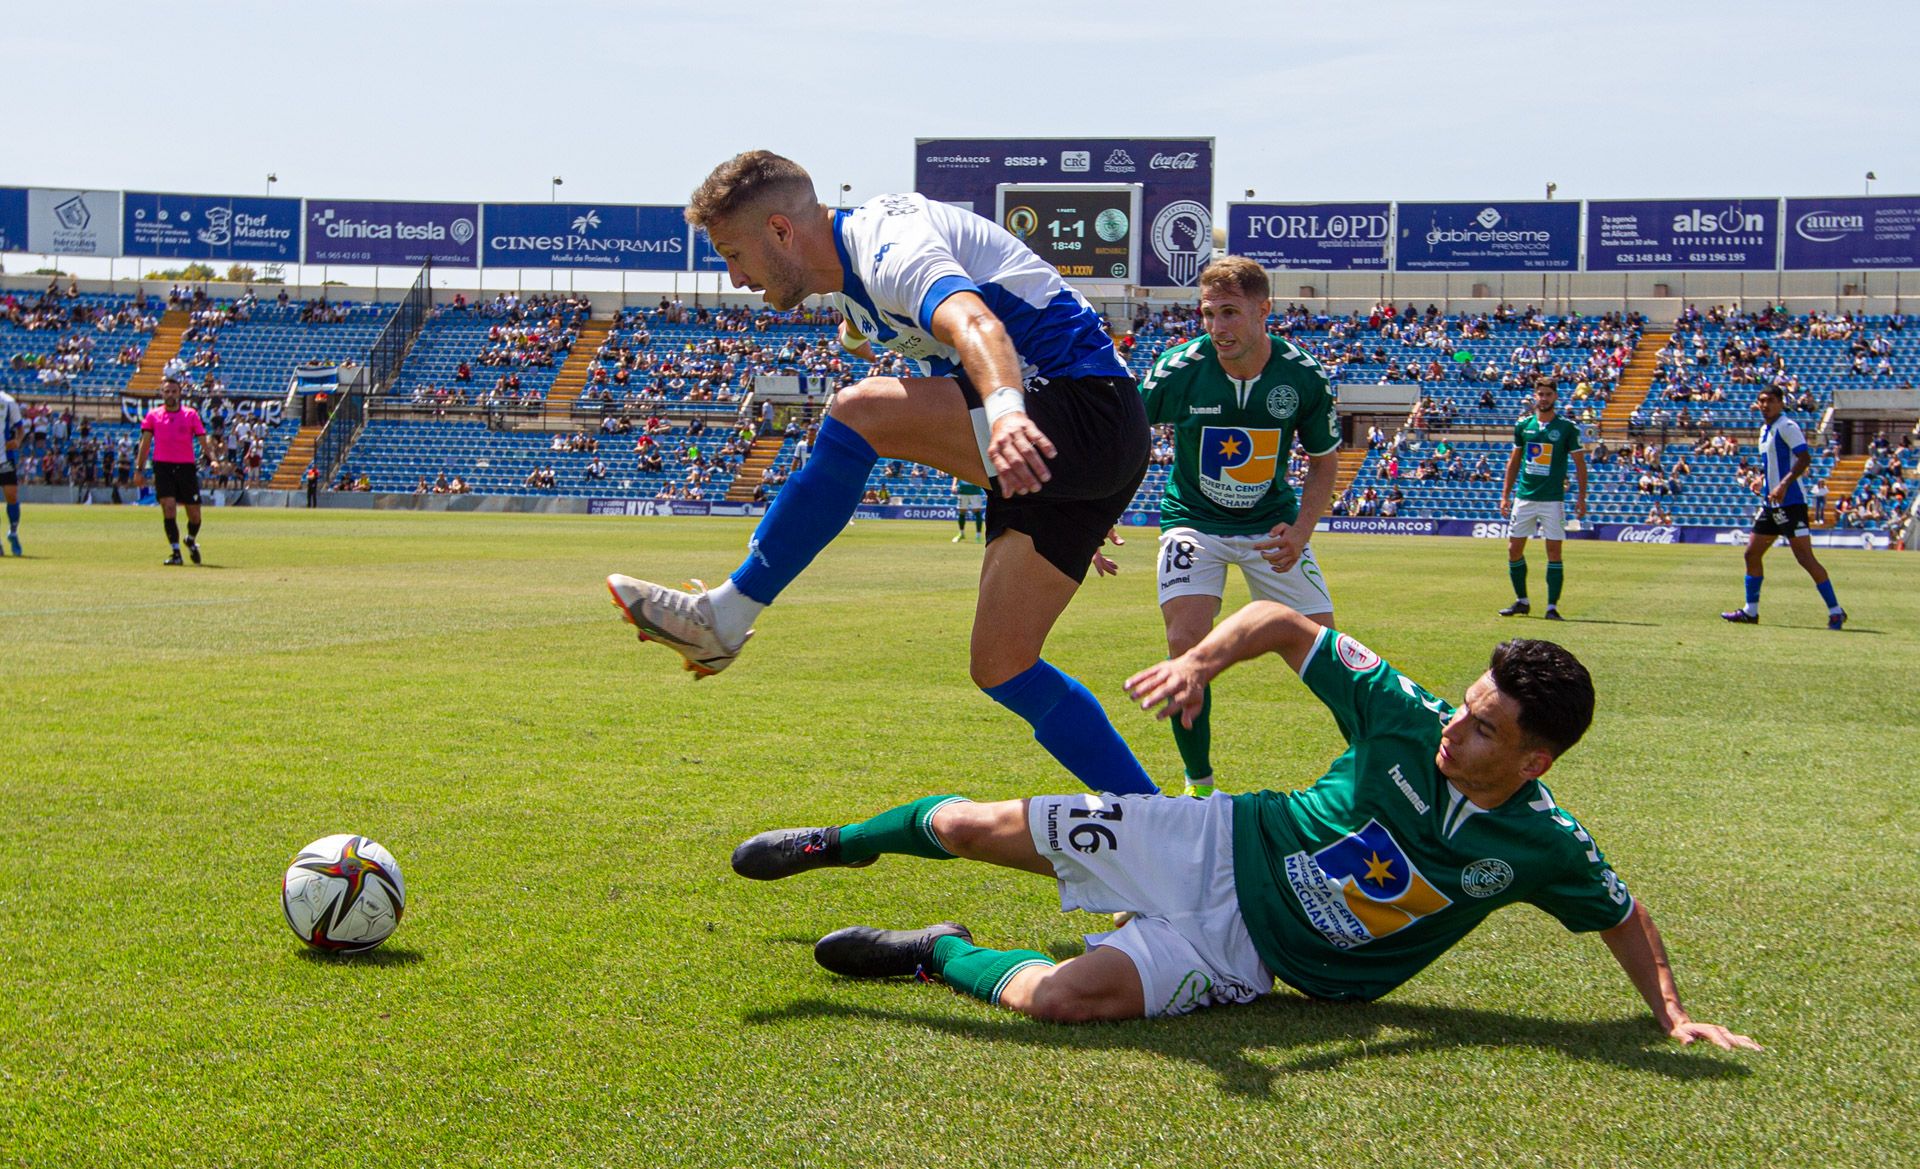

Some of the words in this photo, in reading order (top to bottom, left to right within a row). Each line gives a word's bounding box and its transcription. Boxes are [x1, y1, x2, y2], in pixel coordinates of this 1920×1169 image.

[1063, 158, 1087, 167] CRC
[234, 213, 268, 226] Chef
[1247, 215, 1389, 238] FORLOPD
[1806, 215, 1864, 228] auren
[234, 225, 291, 239] Maestro
[326, 219, 391, 239] clínica
[395, 221, 446, 240] tesla
[1426, 229, 1550, 245] gabinetesme
[566, 235, 682, 253] PANORAMIS
[1051, 241, 1082, 250] 18:49
[1617, 254, 1634, 262] 626
[1189, 404, 1222, 415] hummel
[1164, 540, 1196, 574] 18
[1160, 575, 1191, 591] hummel
[1387, 763, 1431, 816] hummel
[1047, 803, 1063, 852] hummel
[1068, 802, 1124, 854] 16
[1285, 856, 1350, 949] MARCHAMALO
[1307, 857, 1333, 898] UERTA
[1332, 900, 1371, 941] CENTRO
